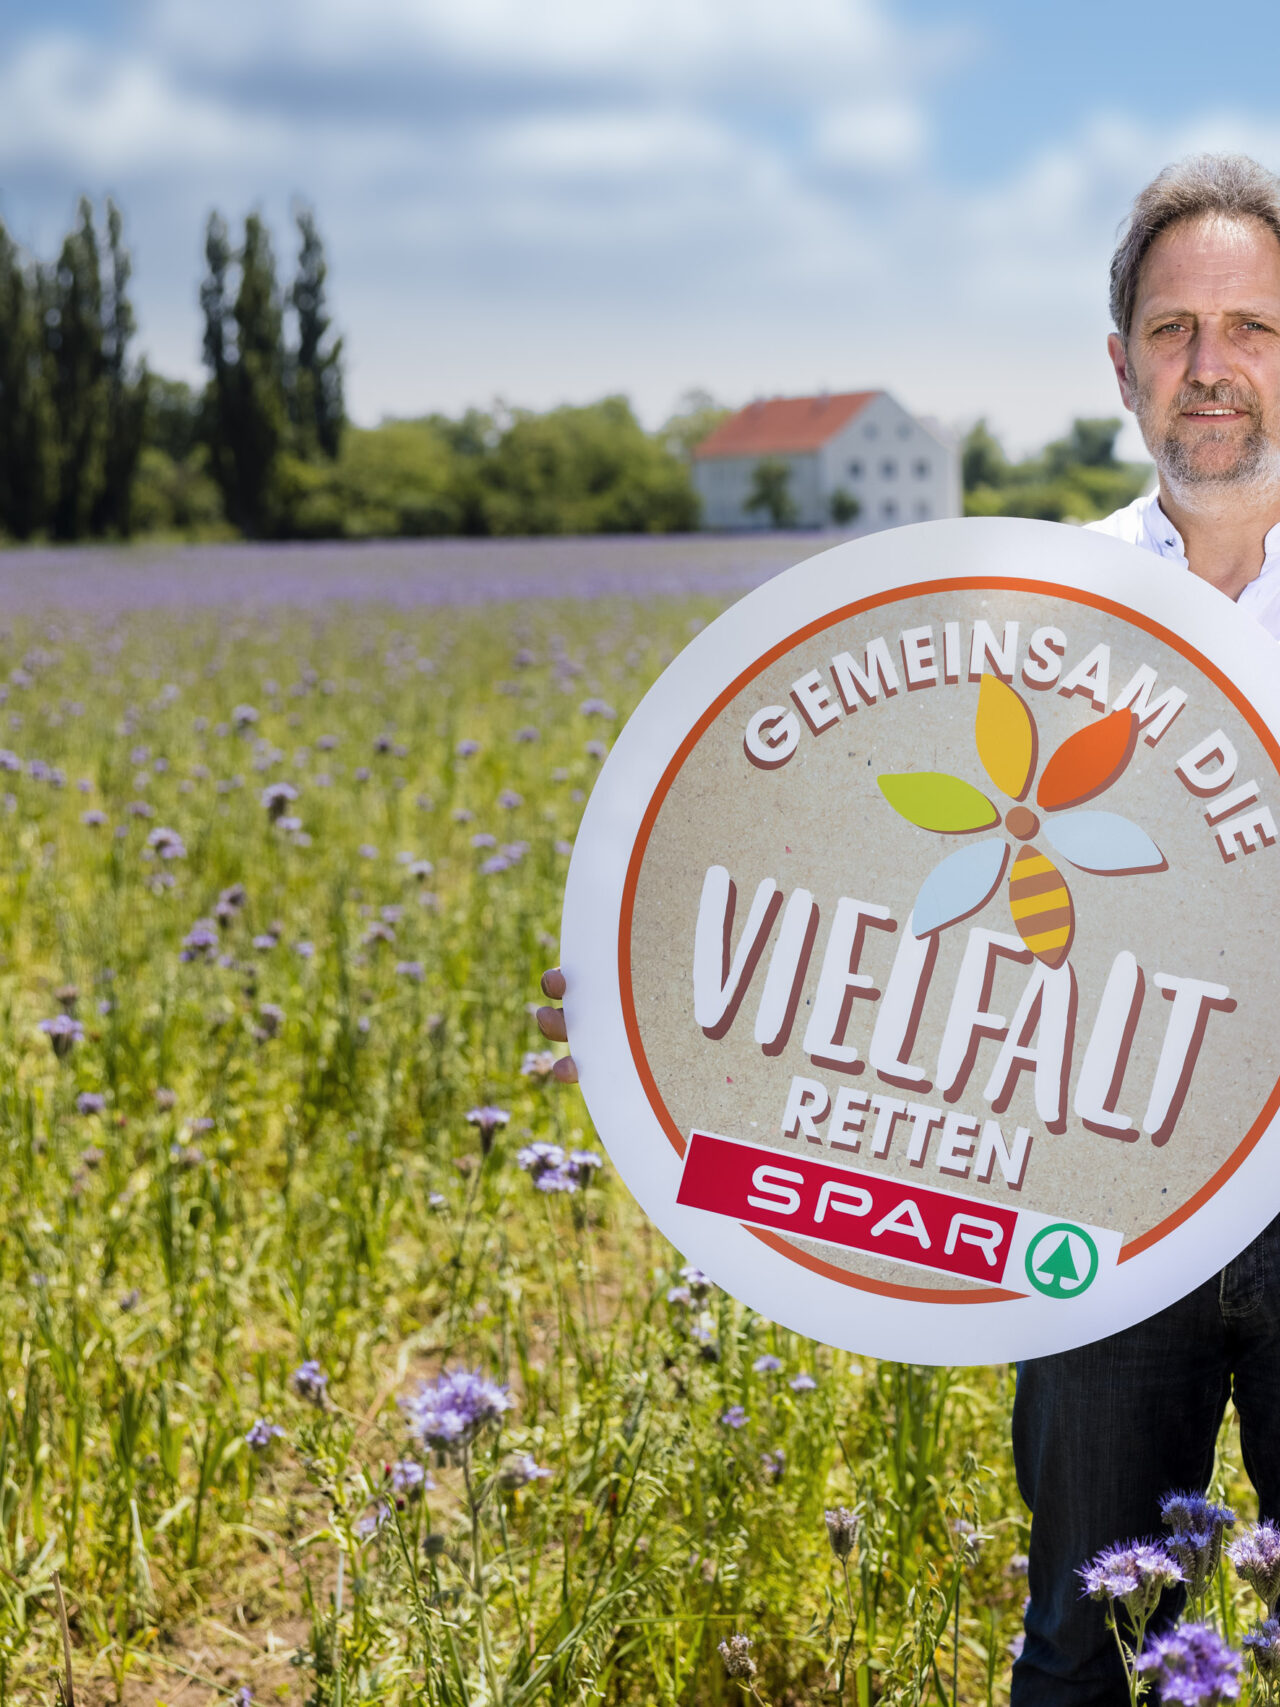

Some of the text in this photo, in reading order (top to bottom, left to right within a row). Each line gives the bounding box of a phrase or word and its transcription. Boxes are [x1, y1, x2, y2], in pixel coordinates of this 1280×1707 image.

[743, 620, 1278, 864] GEMEINSAM DIE
[692, 866, 1237, 1147] VIELFALT
[746, 1164, 1006, 1267] SPAR
[781, 1076, 1034, 1190] RETTEN
